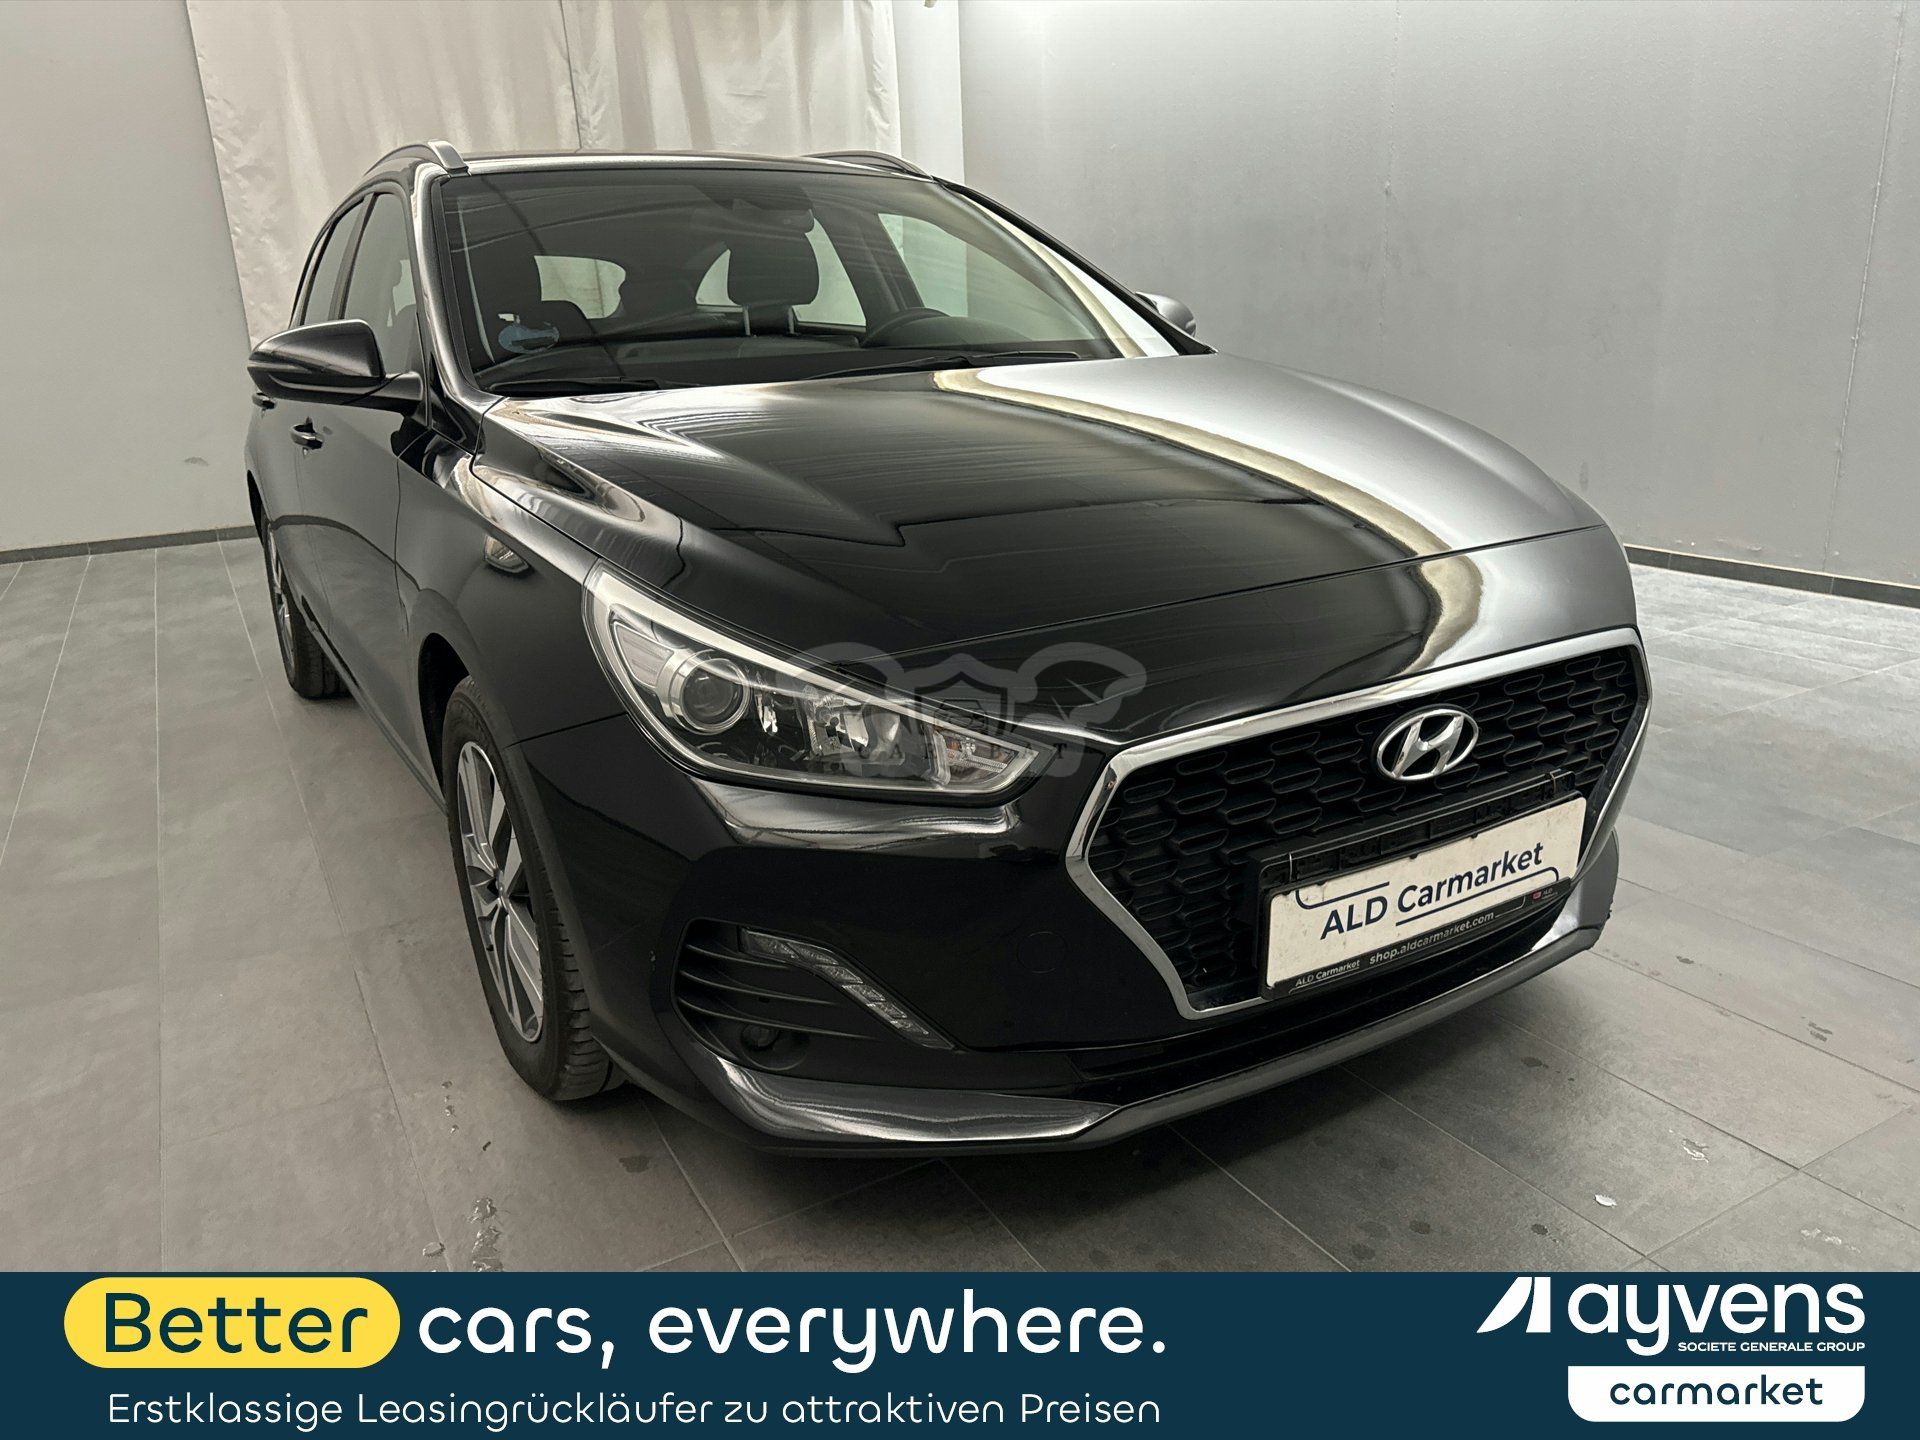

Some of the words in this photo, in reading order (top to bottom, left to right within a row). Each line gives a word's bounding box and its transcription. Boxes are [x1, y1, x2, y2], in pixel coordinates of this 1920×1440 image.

[1320, 895, 1388, 941] ALD
[1397, 842, 1544, 913] Carmarket
[1369, 911, 1495, 965] shop.aldcarmarket.com
[1295, 973, 1314, 987] ALD
[1315, 959, 1360, 980] Carmarket
